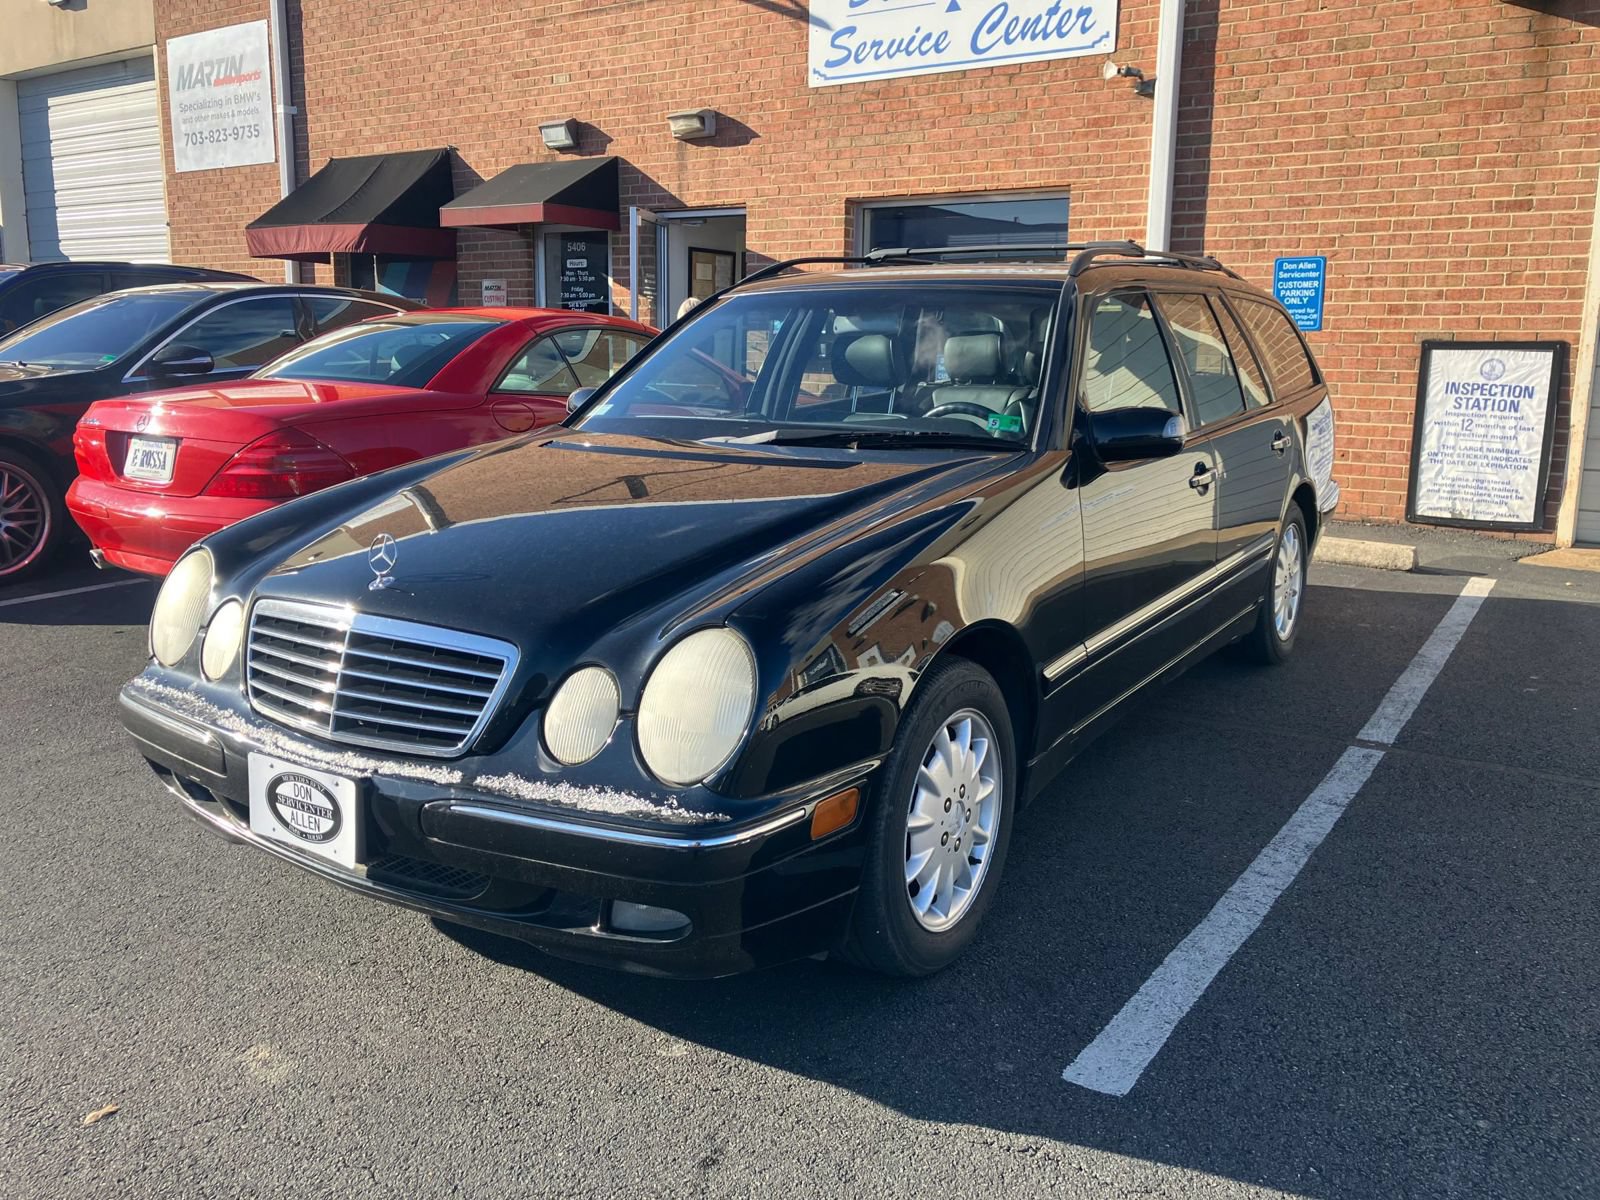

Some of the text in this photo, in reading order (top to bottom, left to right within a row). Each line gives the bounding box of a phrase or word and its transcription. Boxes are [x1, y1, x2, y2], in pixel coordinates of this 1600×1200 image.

[824, 0, 1097, 68] Service Center
[176, 54, 244, 92] MARTIN
[179, 91, 261, 114] Specializing in BMW's
[182, 106, 260, 125] and other makes & models
[184, 123, 260, 147] 703-823-9735
[567, 241, 586, 252] 5406
[1283, 262, 1317, 270] Don Allen
[1279, 271, 1320, 279] Servicenter
[1278, 280, 1319, 289] CUSTOMER
[1280, 289, 1315, 297] PARKING
[1284, 297, 1309, 305] ONLY
[1445, 381, 1535, 399] INSPECTION
[1453, 396, 1521, 413] STATION
[1445, 410, 1525, 421] Inspection required
[1461, 418, 1474, 432] 12
[1475, 422, 1506, 430] months
[1446, 431, 1518, 441] inspection month
[1486, 447, 1520, 455] NUMBER
[131, 448, 167, 470] E ROSSA
[1481, 461, 1529, 471] EXPIRATION
[1491, 456, 1533, 464] INDICATES
[293, 783, 312, 802] DON
[277, 794, 333, 819] SERVICENTER
[290, 810, 320, 832] ALLEN
